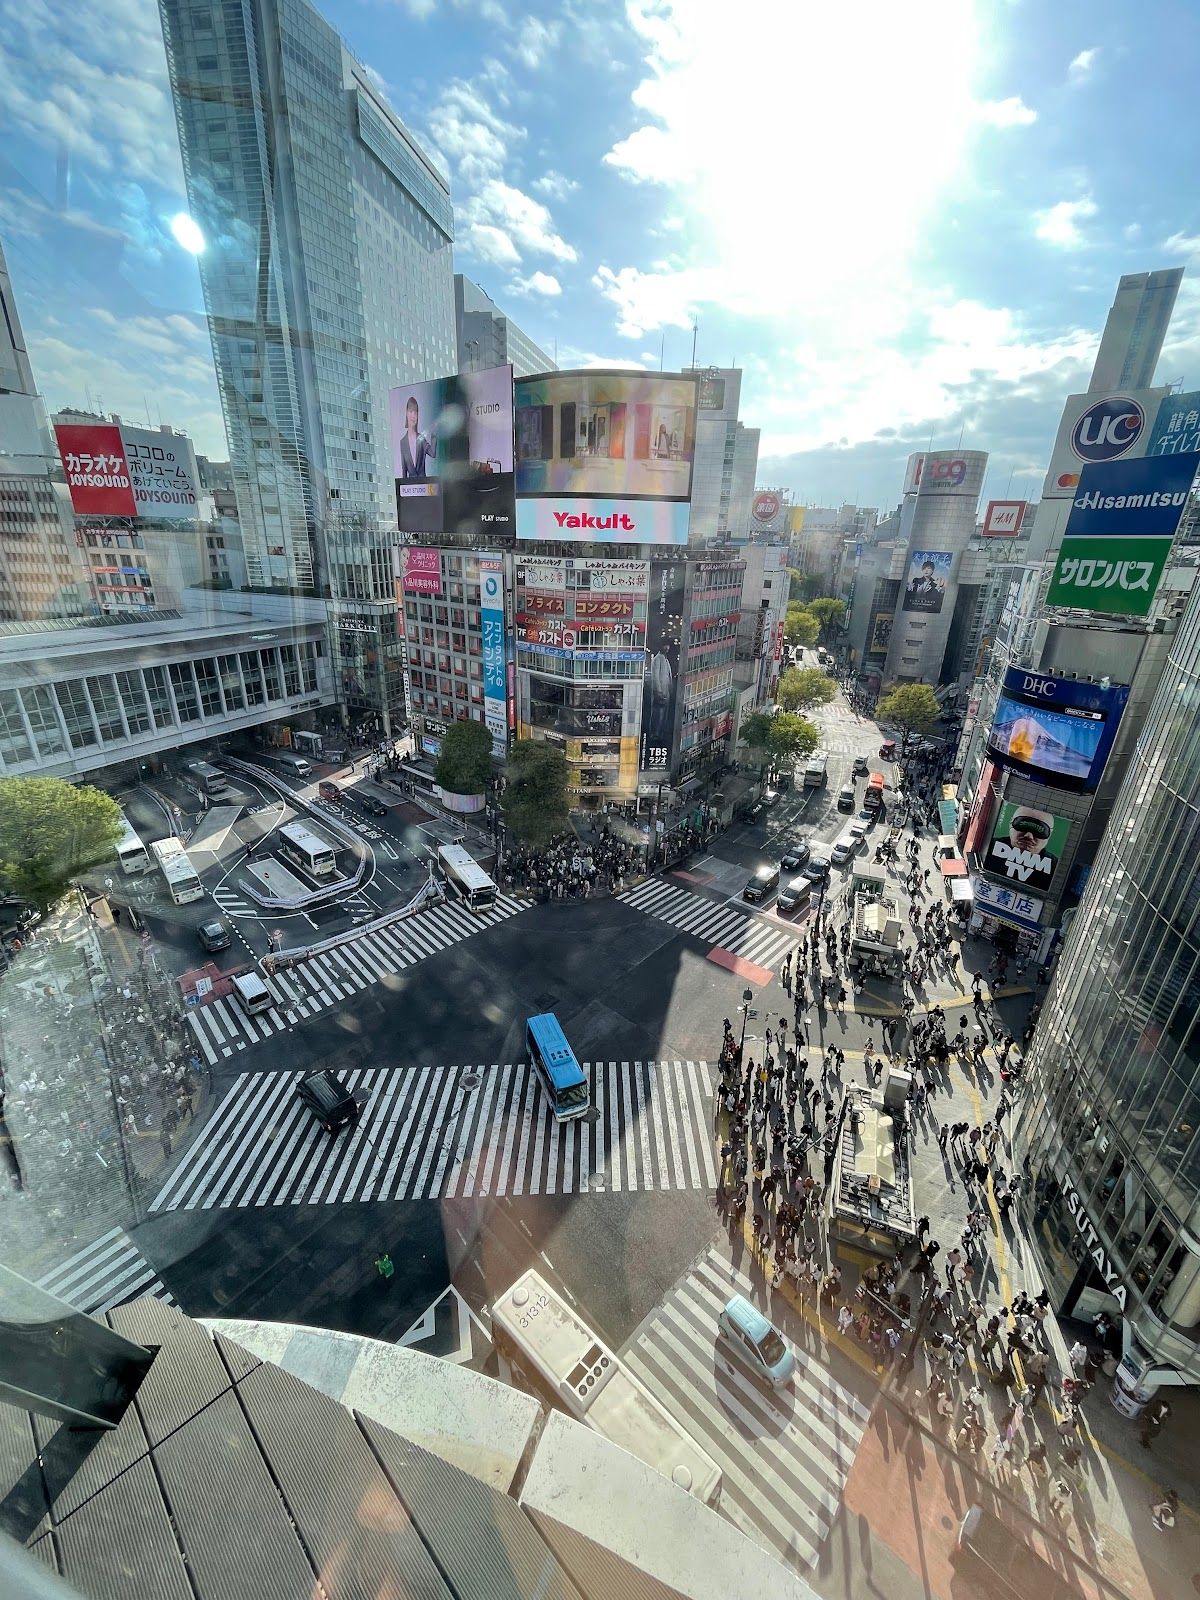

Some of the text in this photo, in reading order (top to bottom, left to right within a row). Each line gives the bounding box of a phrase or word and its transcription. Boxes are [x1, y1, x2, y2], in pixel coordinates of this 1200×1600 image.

[475, 403, 500, 415] STUDIO
[1167, 409, 1200, 433] 龍角
[1080, 413, 1138, 447] UC
[125, 443, 175, 462] ココロの
[65, 453, 123, 473] カラオケ
[70, 474, 129, 488] JOYSOUND
[930, 460, 967, 485] 109
[135, 489, 196, 505] JOYSOUND
[1074, 490, 1187, 510] Hisamitsu
[481, 514, 495, 522] PLAY
[553, 511, 636, 532] Yakult
[994, 512, 1015, 524] H&M
[585, 561, 646, 570] しゃぶしゃぶバイキング
[517, 570, 525, 579] 9F
[611, 574, 647, 587] しゃぶ葉
[1058, 558, 1155, 592] サロンパス
[527, 597, 564, 610] プライス
[576, 602, 632, 615] コンタクト
[357, 623, 377, 631] CITY
[614, 624, 640, 634] ガスト
[539, 630, 562, 645] ガスト
[484, 620, 495, 686] アイシティ
[494, 622, 504, 688] コンタクトの
[1022, 676, 1057, 697] DHC
[649, 747, 668, 756] TBS
[649, 756, 667, 764] ラジオ
[992, 840, 1053, 875] DMM
[1005, 860, 1035, 882] TV
[1062, 1173, 1127, 1313] TSUTAYA
[519, 1295, 550, 1328] 31312
